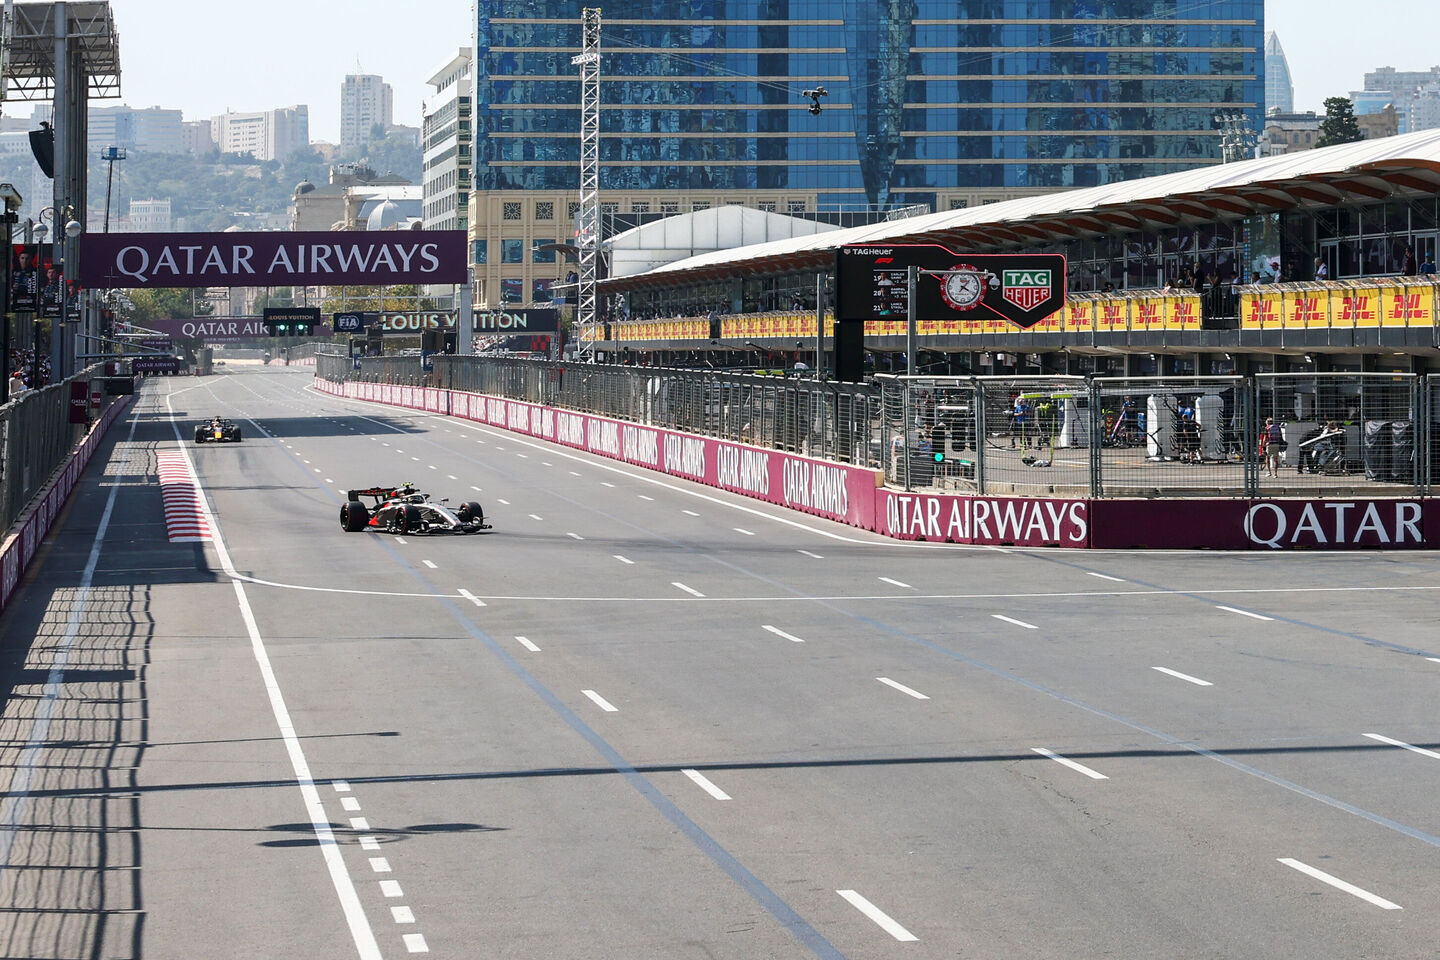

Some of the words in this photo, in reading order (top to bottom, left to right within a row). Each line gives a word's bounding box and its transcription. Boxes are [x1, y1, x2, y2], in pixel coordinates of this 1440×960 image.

[116, 244, 255, 282] QATAR
[267, 243, 440, 273] AIRWAYS
[1007, 272, 1048, 284] TAG
[1006, 289, 1048, 307] HEUER
[1342, 296, 1372, 320] DHL
[1392, 294, 1424, 319] DHL
[1138, 304, 1158, 324] DHL
[1173, 303, 1194, 322] DHL
[1250, 300, 1274, 322] DHL
[1293, 298, 1320, 321] DHL
[182, 322, 237, 337] QATAR
[242, 322, 270, 335] AIR
[340, 318, 356, 327] FIA
[382, 314, 439, 330] LOUIS
[444, 313, 527, 329] VITTON
[717, 444, 739, 487] QATAR
[740, 448, 769, 495] AIRWAYS
[783, 458, 810, 506] QATAR
[811, 464, 848, 516] AIRWAYS
[886, 494, 942, 537] QATAR
[947, 498, 1088, 542] AIRWAYS
[1243, 502, 1426, 548] QATAR
